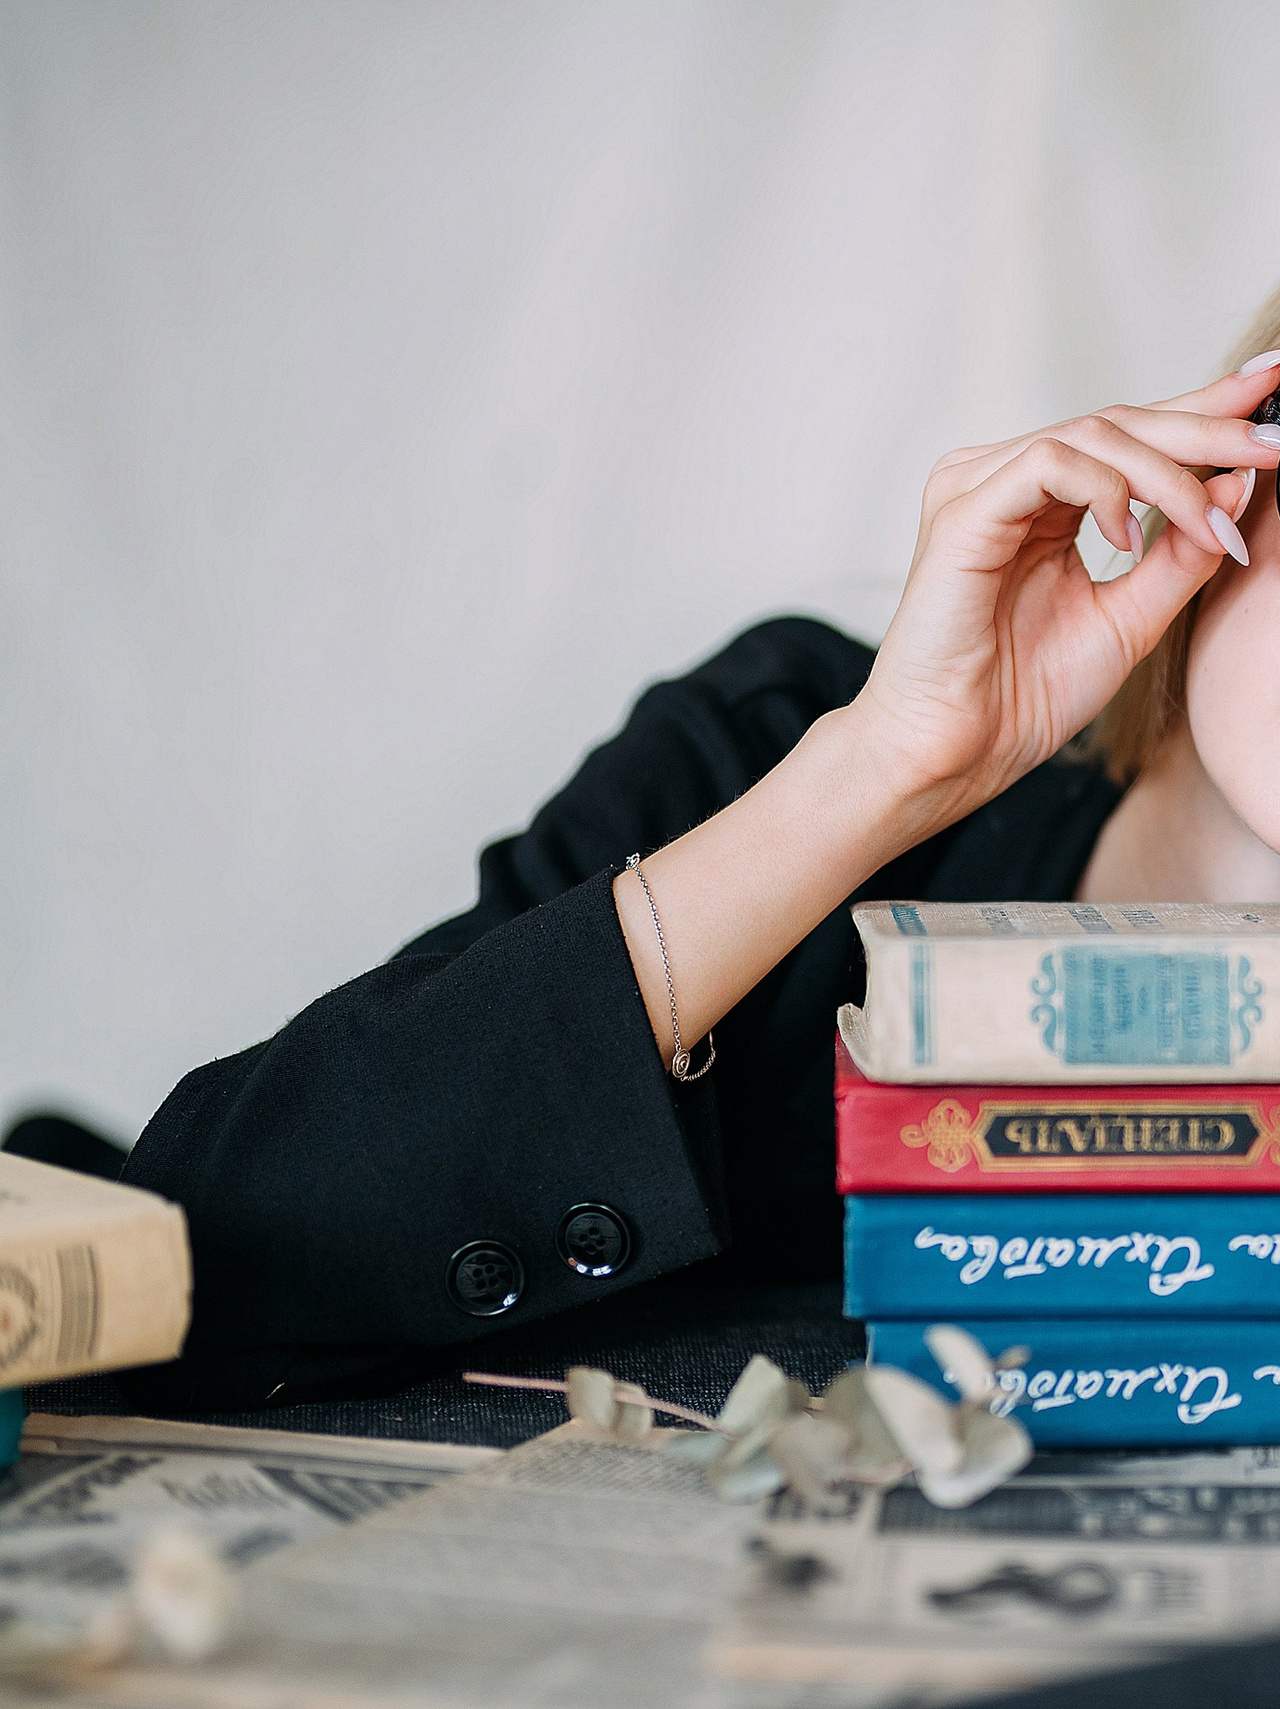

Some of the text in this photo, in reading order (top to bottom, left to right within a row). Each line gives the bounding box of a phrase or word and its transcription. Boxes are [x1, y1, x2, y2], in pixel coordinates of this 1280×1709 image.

[1004, 1115, 1236, 1153] СТЕНДАЛЬ
[914, 1226, 1216, 1297] Ахматова
[943, 1362, 1243, 1425] Ахматов
